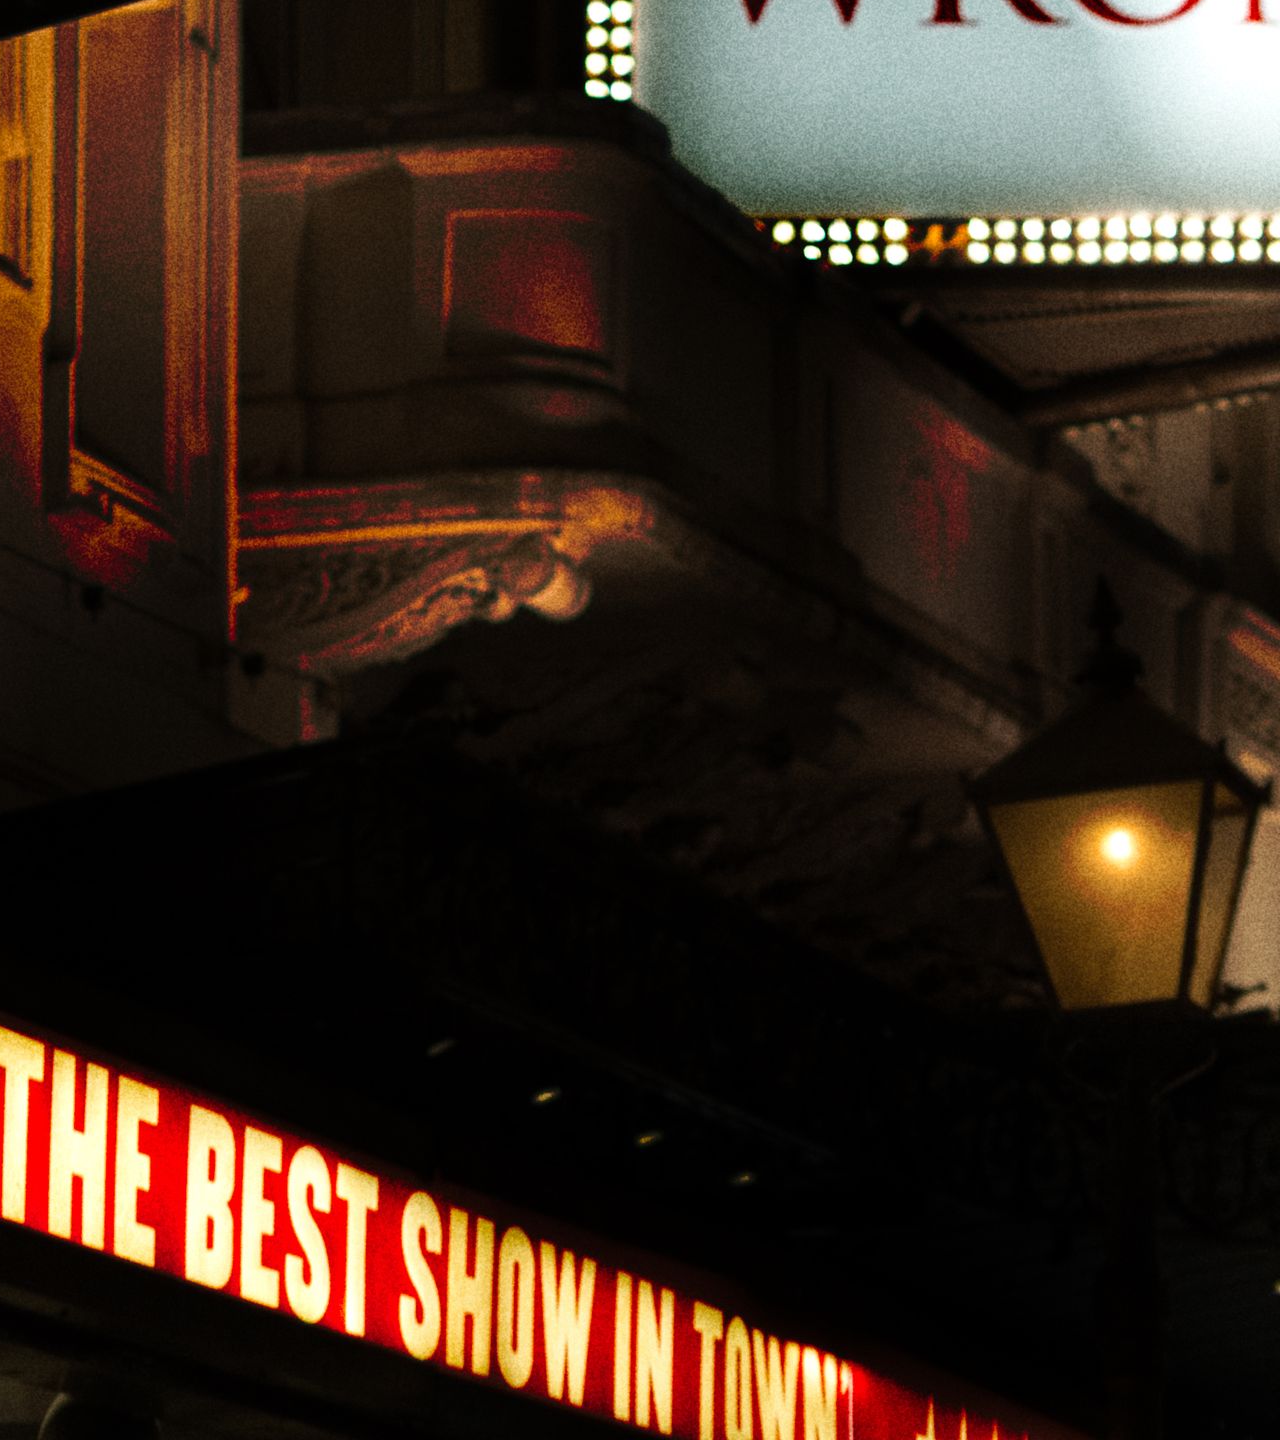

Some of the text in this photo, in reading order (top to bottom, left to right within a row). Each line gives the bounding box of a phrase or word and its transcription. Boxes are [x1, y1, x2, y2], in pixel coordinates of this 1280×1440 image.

[184, 1086, 379, 1340] BEST
[397, 1190, 599, 1408] SHOW
[615, 1269, 675, 1436] IN
